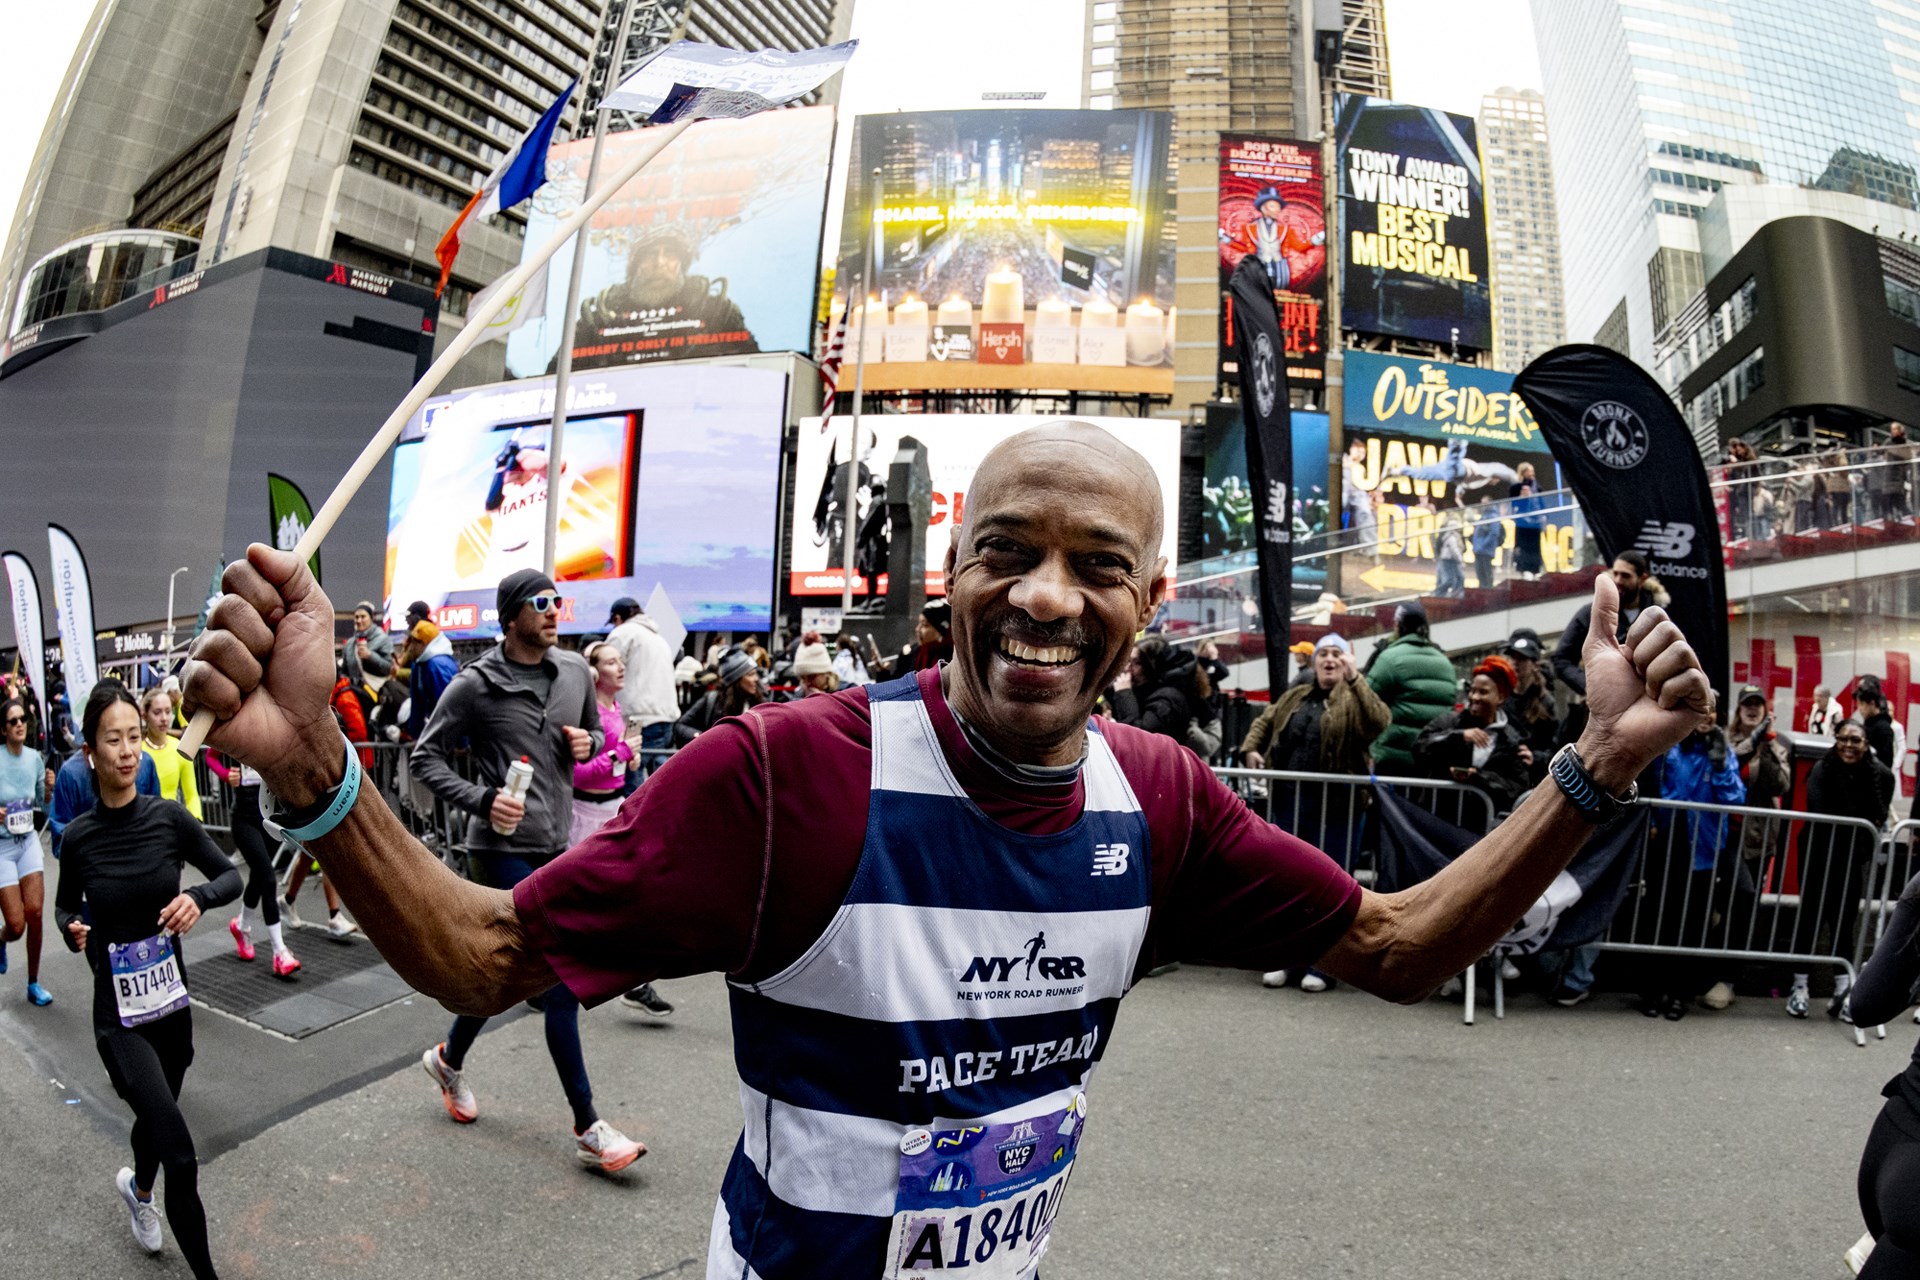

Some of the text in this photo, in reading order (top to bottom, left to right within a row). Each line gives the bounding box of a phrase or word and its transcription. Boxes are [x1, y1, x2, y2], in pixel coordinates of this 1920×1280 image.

[1230, 148, 1312, 165] DRAG QUEEN
[1243, 141, 1299, 156] BOB THE
[1349, 148, 1469, 187] TONY AWARD
[1350, 169, 1471, 219] WINNER!
[873, 206, 1145, 223] SHARE. HONOR. REMEMBER.
[1378, 203, 1450, 245] BEST
[1351, 230, 1478, 283] MUSICAL
[170, 270, 206, 290] MARRIOTT
[350, 278, 388, 296] MARQUIS
[352, 269, 395, 288] MARRIOTT
[167, 281, 200, 300] MARQUIS
[12, 333, 39, 351] MARQUIS
[13, 323, 45, 342] MARRIOTT
[621, 342, 634, 353] 13
[635, 338, 666, 350] ONLY
[670, 336, 684, 348] IN
[687, 331, 750, 345] THEATERS
[981, 330, 1021, 347] Hersh
[1591, 404, 1633, 424] BRONX
[1586, 438, 1644, 466] BURNERS
[1649, 560, 1708, 579] balance
[439, 609, 473, 627] LIVE
[333, 784, 355, 816] Team
[1090, 843, 1130, 876] NB
[119, 961, 175, 998] B17440
[957, 984, 1084, 1001] NEW YORK ROAD RUNNERS
[898, 1051, 1002, 1094] PACE
[903, 1138, 930, 1152] MEMBERS
[998, 1136, 1040, 1150] UNITED AIRLINES
[1004, 1145, 1031, 1161] NYC
[1005, 1156, 1027, 1169] HALF
